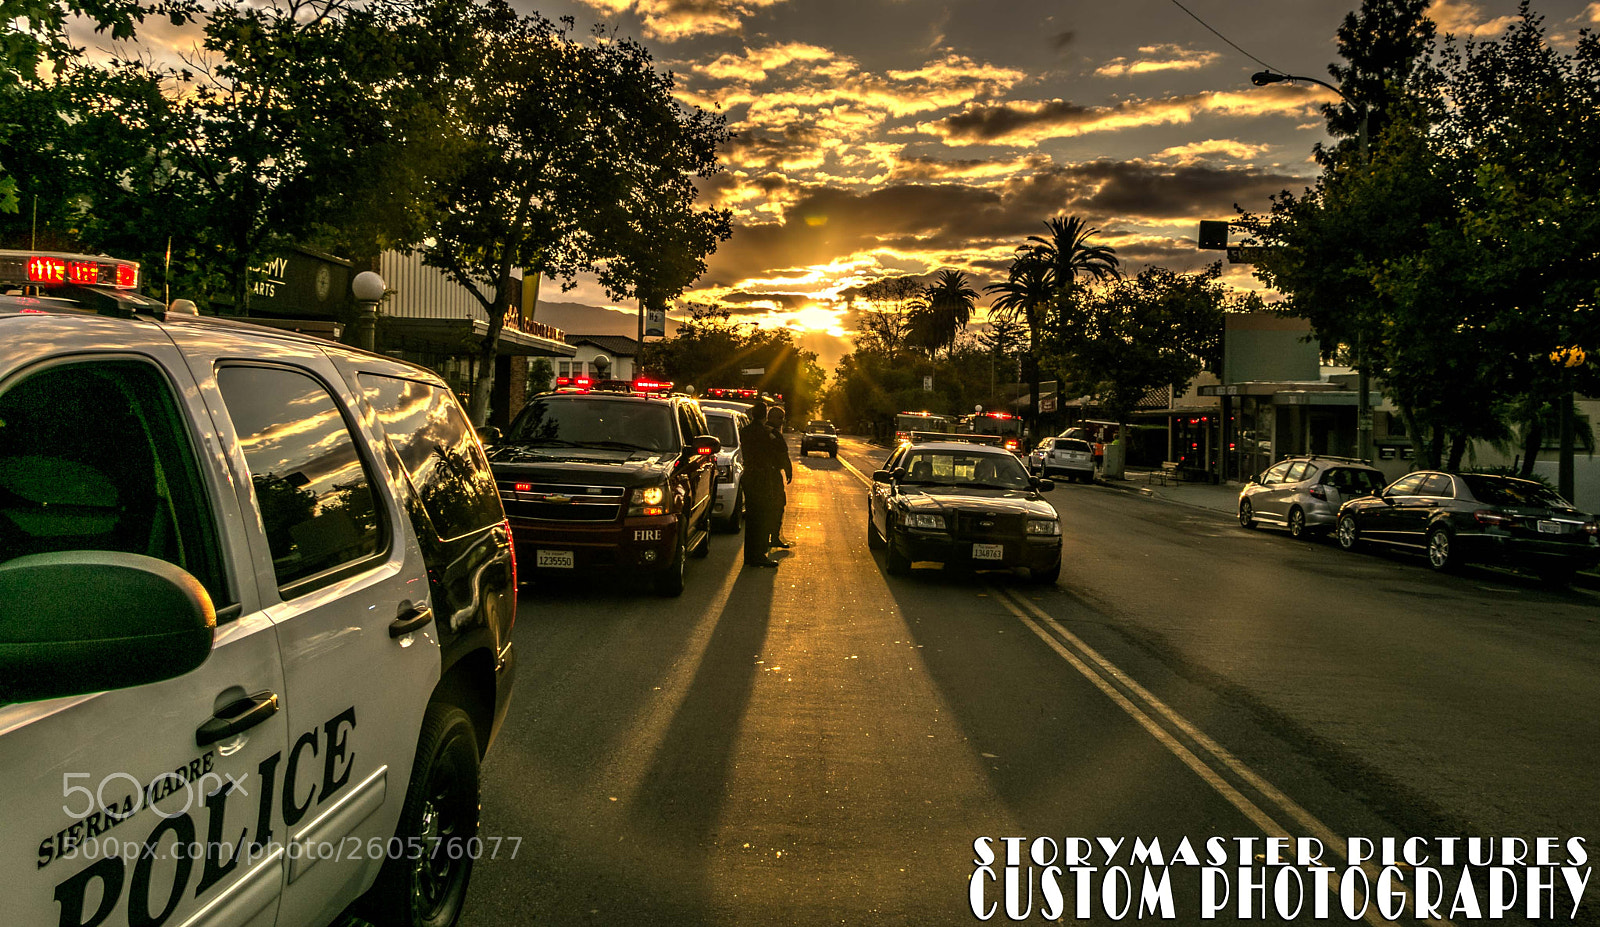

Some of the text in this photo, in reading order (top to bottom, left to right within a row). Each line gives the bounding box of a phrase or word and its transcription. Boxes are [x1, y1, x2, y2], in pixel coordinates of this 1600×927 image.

[253, 281, 276, 298] ARTS
[633, 529, 662, 541] FIRE
[539, 556, 572, 566] 1235550
[37, 751, 215, 870] SIERRA MADRE
[53, 705, 357, 927] POLICE
